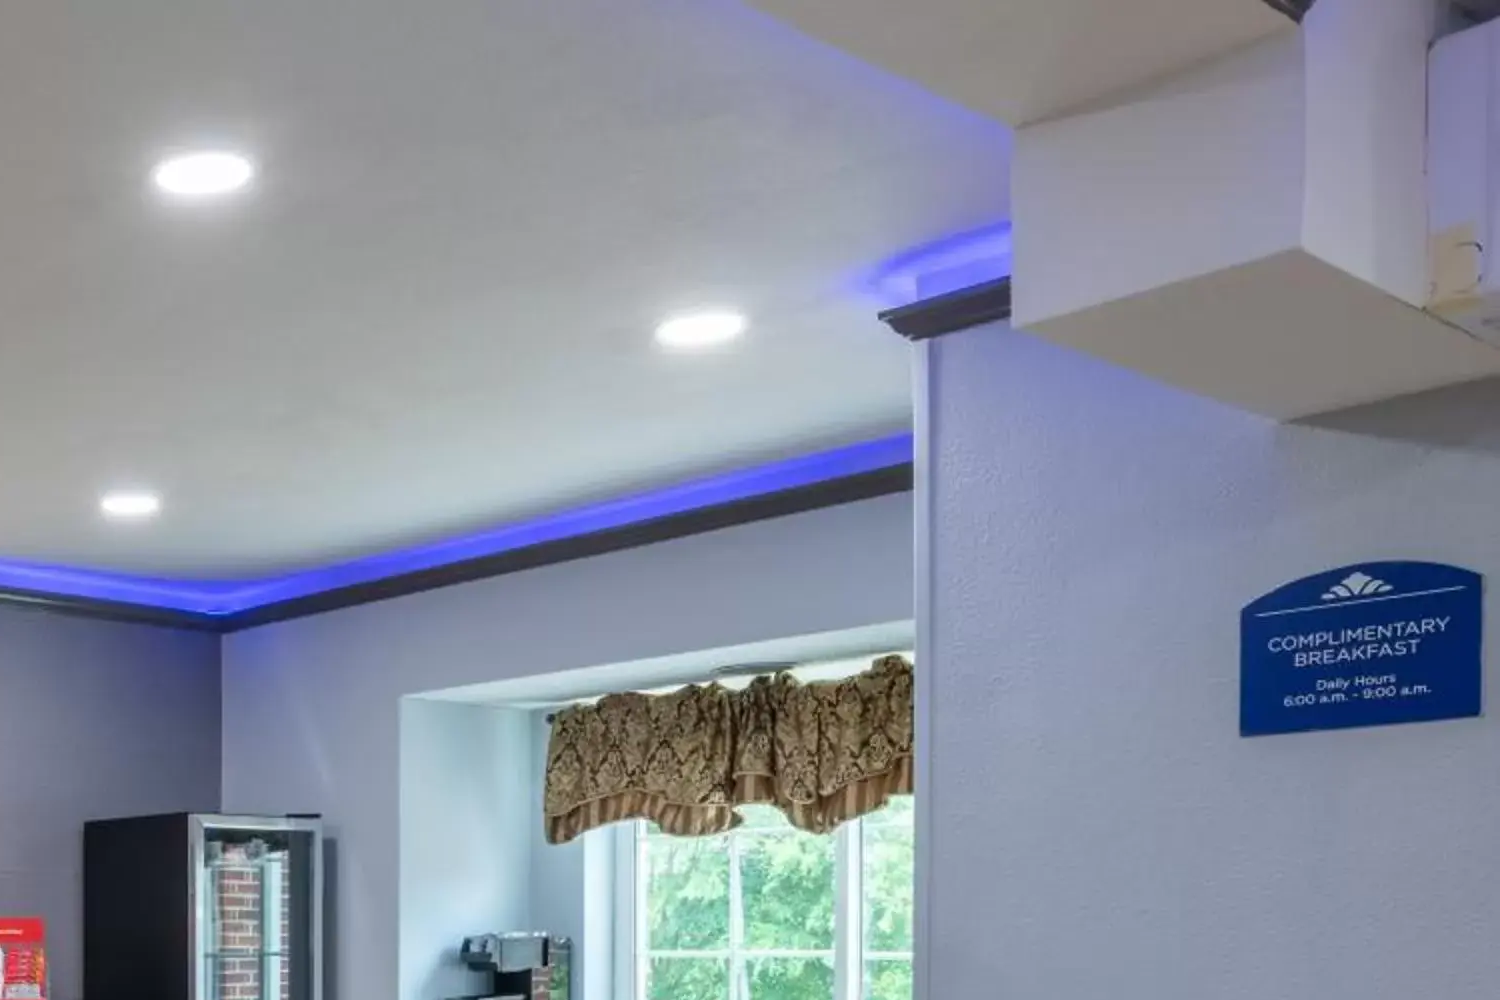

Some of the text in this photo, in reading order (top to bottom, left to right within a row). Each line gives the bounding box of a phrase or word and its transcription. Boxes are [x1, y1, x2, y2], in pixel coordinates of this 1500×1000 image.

[1267, 616, 1451, 652] COMPLIMENTARY
[1294, 638, 1422, 667] BREAKFAST
[1283, 693, 1316, 707] 6:00
[1319, 692, 1349, 704] a.m.
[1363, 685, 1397, 699] 9:00
[1401, 684, 1432, 696] a.m.
[1315, 674, 1397, 691] Daily Hours
